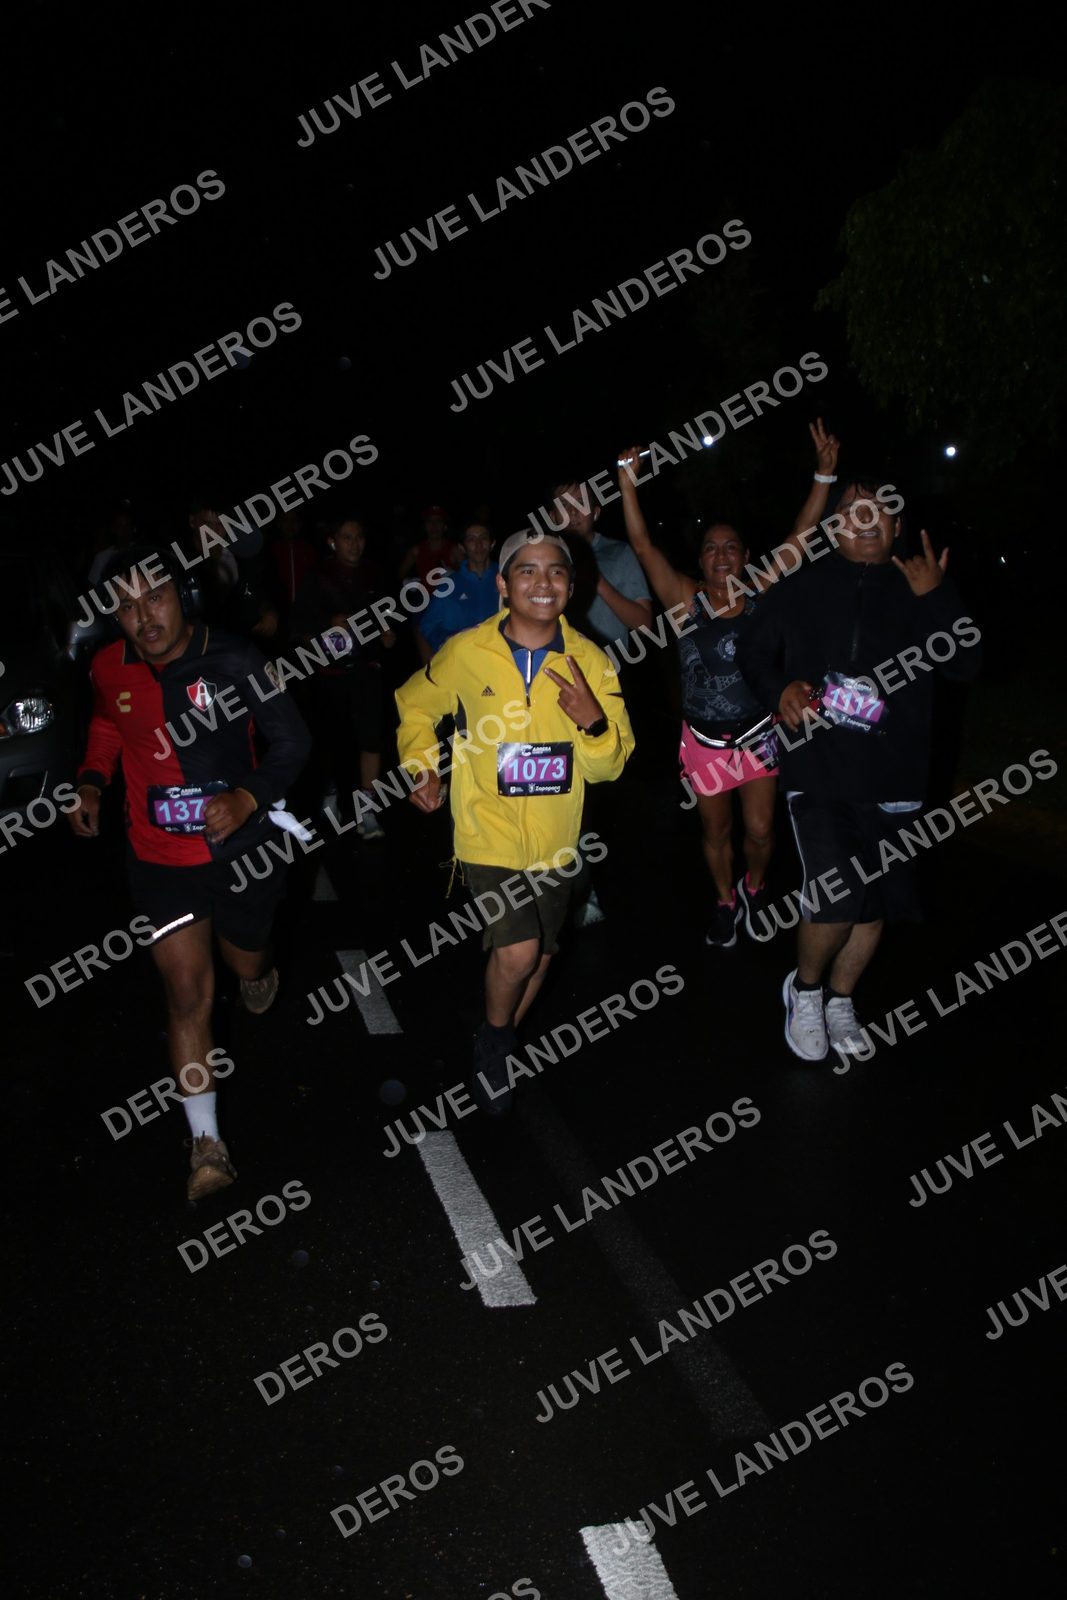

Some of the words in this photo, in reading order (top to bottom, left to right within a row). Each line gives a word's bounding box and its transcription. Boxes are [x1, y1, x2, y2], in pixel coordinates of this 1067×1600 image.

[830, 687, 881, 718] 1117
[508, 757, 565, 780] 1073
[159, 799, 204, 822] 137
